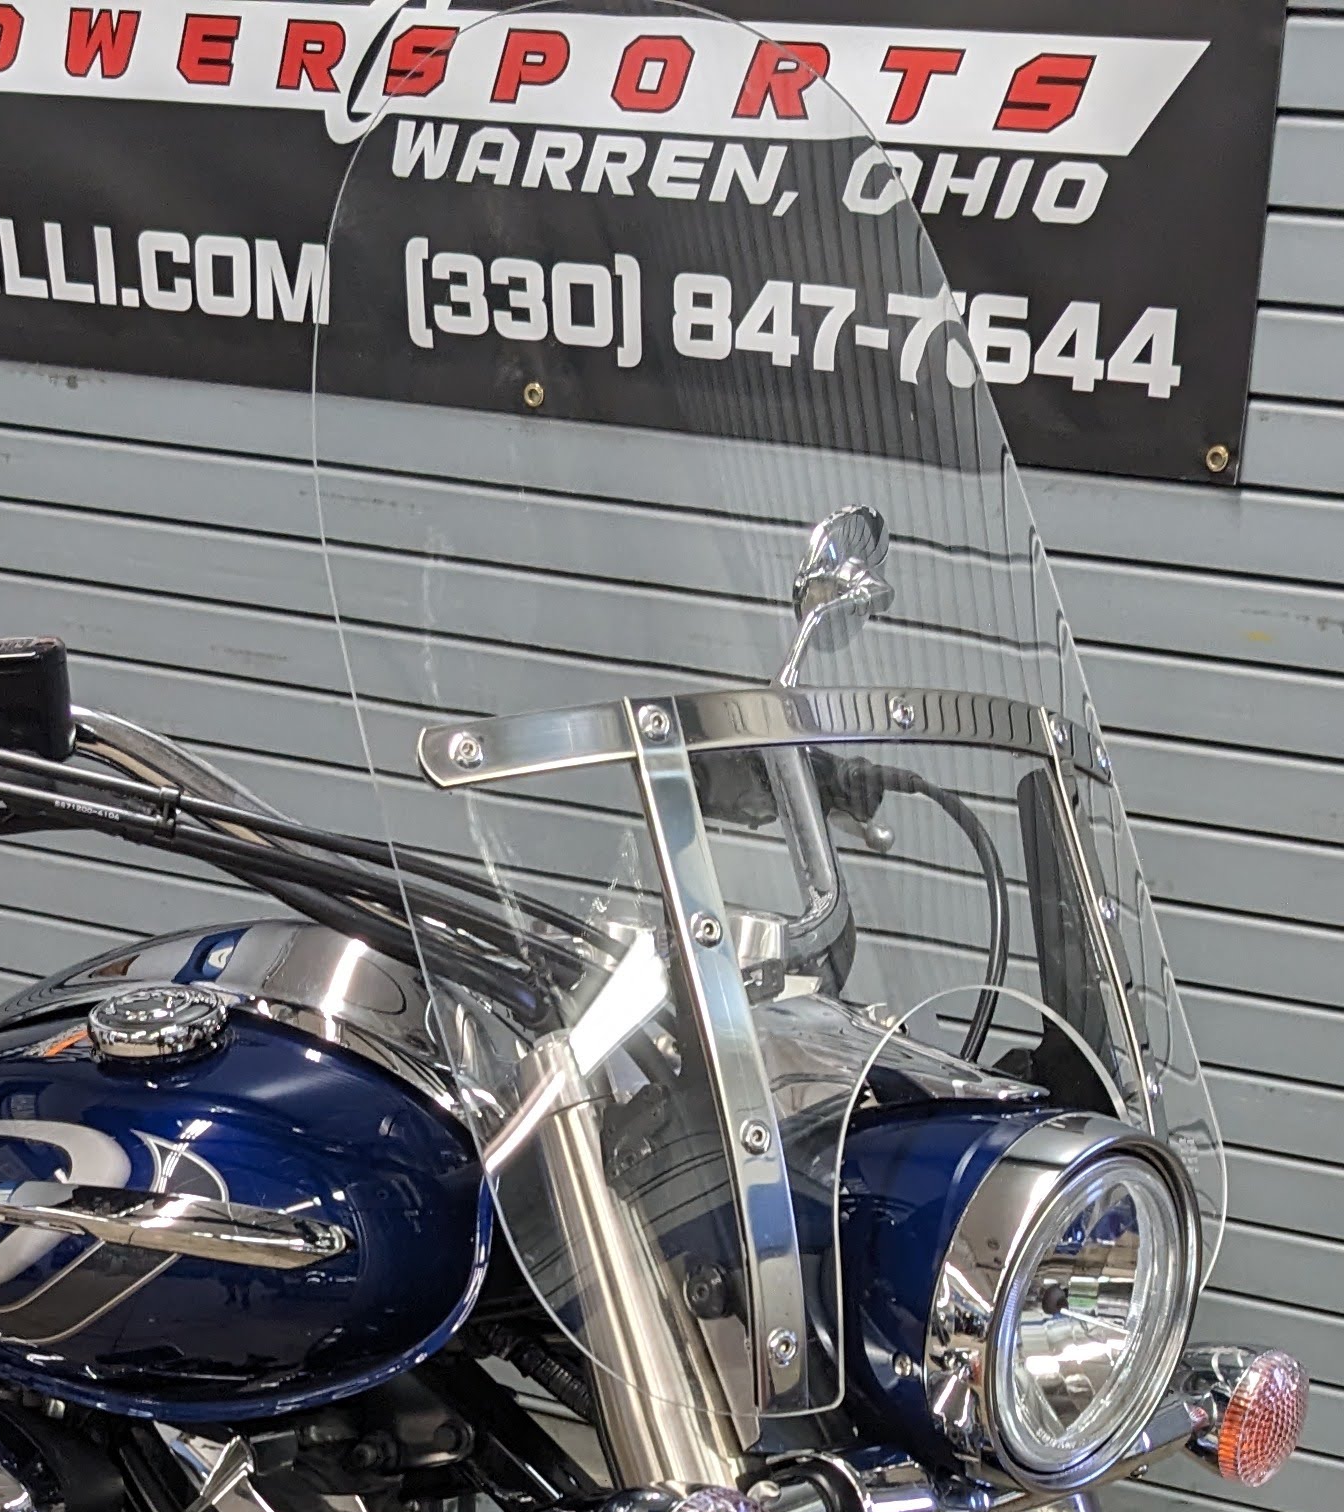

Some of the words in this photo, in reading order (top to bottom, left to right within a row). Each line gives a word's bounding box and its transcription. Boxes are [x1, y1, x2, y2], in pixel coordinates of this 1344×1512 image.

[390, 119, 799, 218] WARREN,
[841, 145, 1109, 224] OHIO
[404, 236, 644, 369] (330)
[672, 272, 1182, 399] 847-7644
